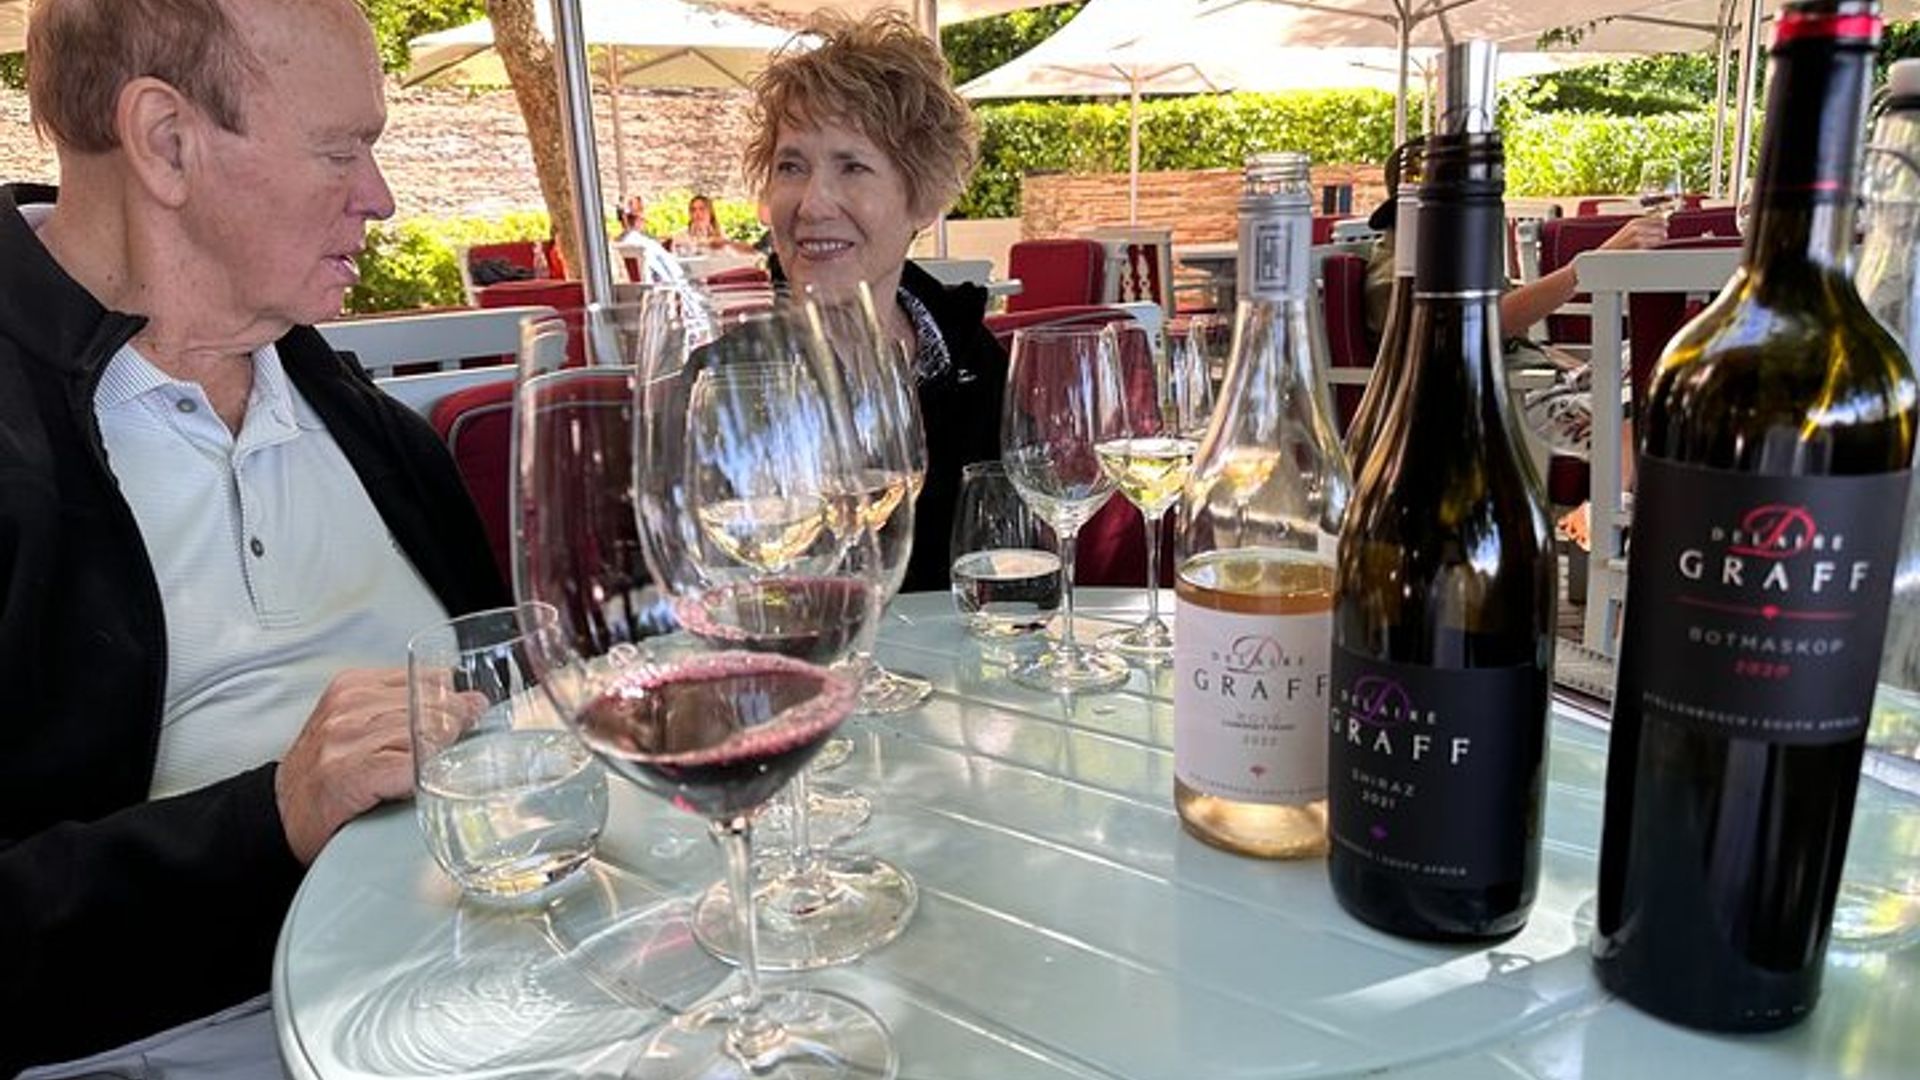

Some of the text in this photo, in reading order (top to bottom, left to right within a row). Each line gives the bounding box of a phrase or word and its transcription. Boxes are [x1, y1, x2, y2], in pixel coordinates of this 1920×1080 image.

[1679, 549, 1871, 593] GRAFF
[1687, 626, 1845, 656] BOTMASKOP
[1193, 667, 1330, 701] GRAFF
[1330, 708, 1471, 765] GRAFF
[1350, 766, 1417, 799] SHIRAZ
[1361, 788, 1397, 810] 2021
